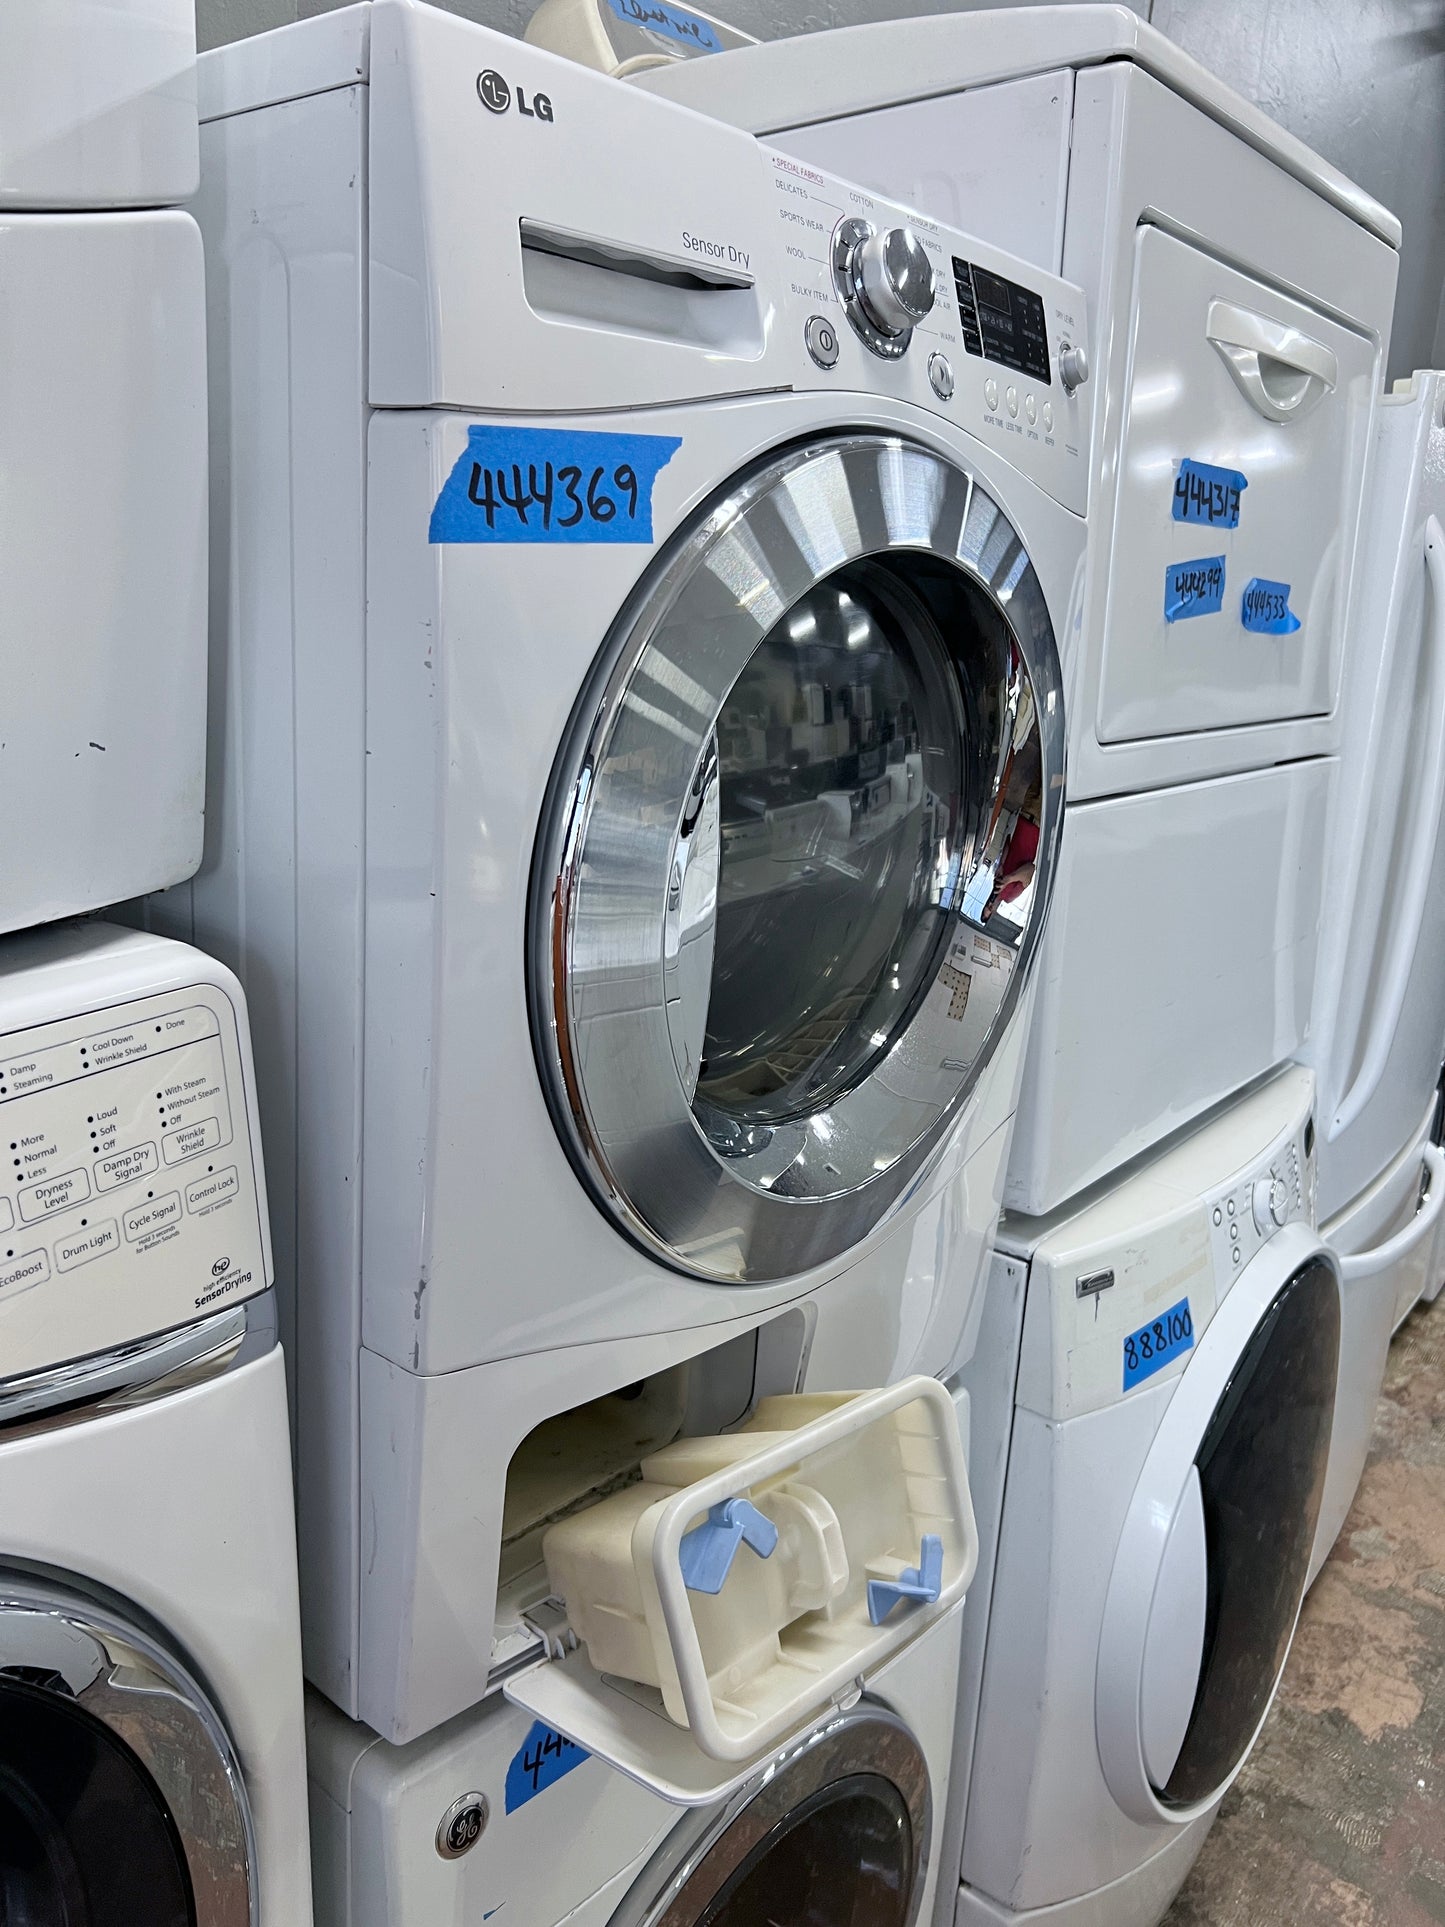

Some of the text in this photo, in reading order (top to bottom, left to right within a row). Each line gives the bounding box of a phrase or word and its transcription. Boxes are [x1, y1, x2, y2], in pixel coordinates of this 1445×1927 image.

[516, 86, 554, 123] LG
[776, 157, 824, 185] SPECIAL FABRICS
[775, 179, 809, 200] DELICATES
[849, 192, 874, 209] COTTON
[779, 208, 824, 231] SPORTS WEAR
[682, 231, 750, 270] Sensor Dry
[785, 245, 807, 260] WOOL
[790, 283, 829, 302] BULKY ITEM
[468, 461, 638, 531] 444369
[1175, 471, 1241, 522] 444317
[1247, 589, 1286, 623] 444533
[166, 1019, 186, 1030] Done
[92, 1034, 134, 1052] Cool Down
[94, 1043, 148, 1066] Wrinkle Shield
[10, 1063, 37, 1076] Damp
[13, 1073, 54, 1091] Steaming
[165, 1076, 207, 1097] With Steam
[167, 1086, 221, 1111] Without Steam
[97, 1106, 118, 1121] Loud
[169, 1114, 182, 1125] Off
[21, 1133, 45, 1148] More
[100, 1124, 117, 1137] Soft
[176, 1127, 206, 1144] Wrinkle
[24, 1144, 58, 1164] Normal
[103, 1139, 116, 1151] Off
[181, 1138, 205, 1154] Shield
[103, 1149, 150, 1173] Damp Dry
[115, 1161, 143, 1180] Signal
[27, 1167, 47, 1180] Less
[35, 1179, 73, 1200] Dryness
[44, 1191, 69, 1209] Level
[189, 1176, 235, 1203] Control Lock
[128, 1202, 176, 1230] Cycle Signal
[62, 1232, 113, 1259] Drum Light
[0, 1261, 43, 1288] EcoBoost
[194, 1271, 252, 1309] SensorDrying
[1123, 1308, 1193, 1370] 888100
[523, 1733, 576, 1791] 44
